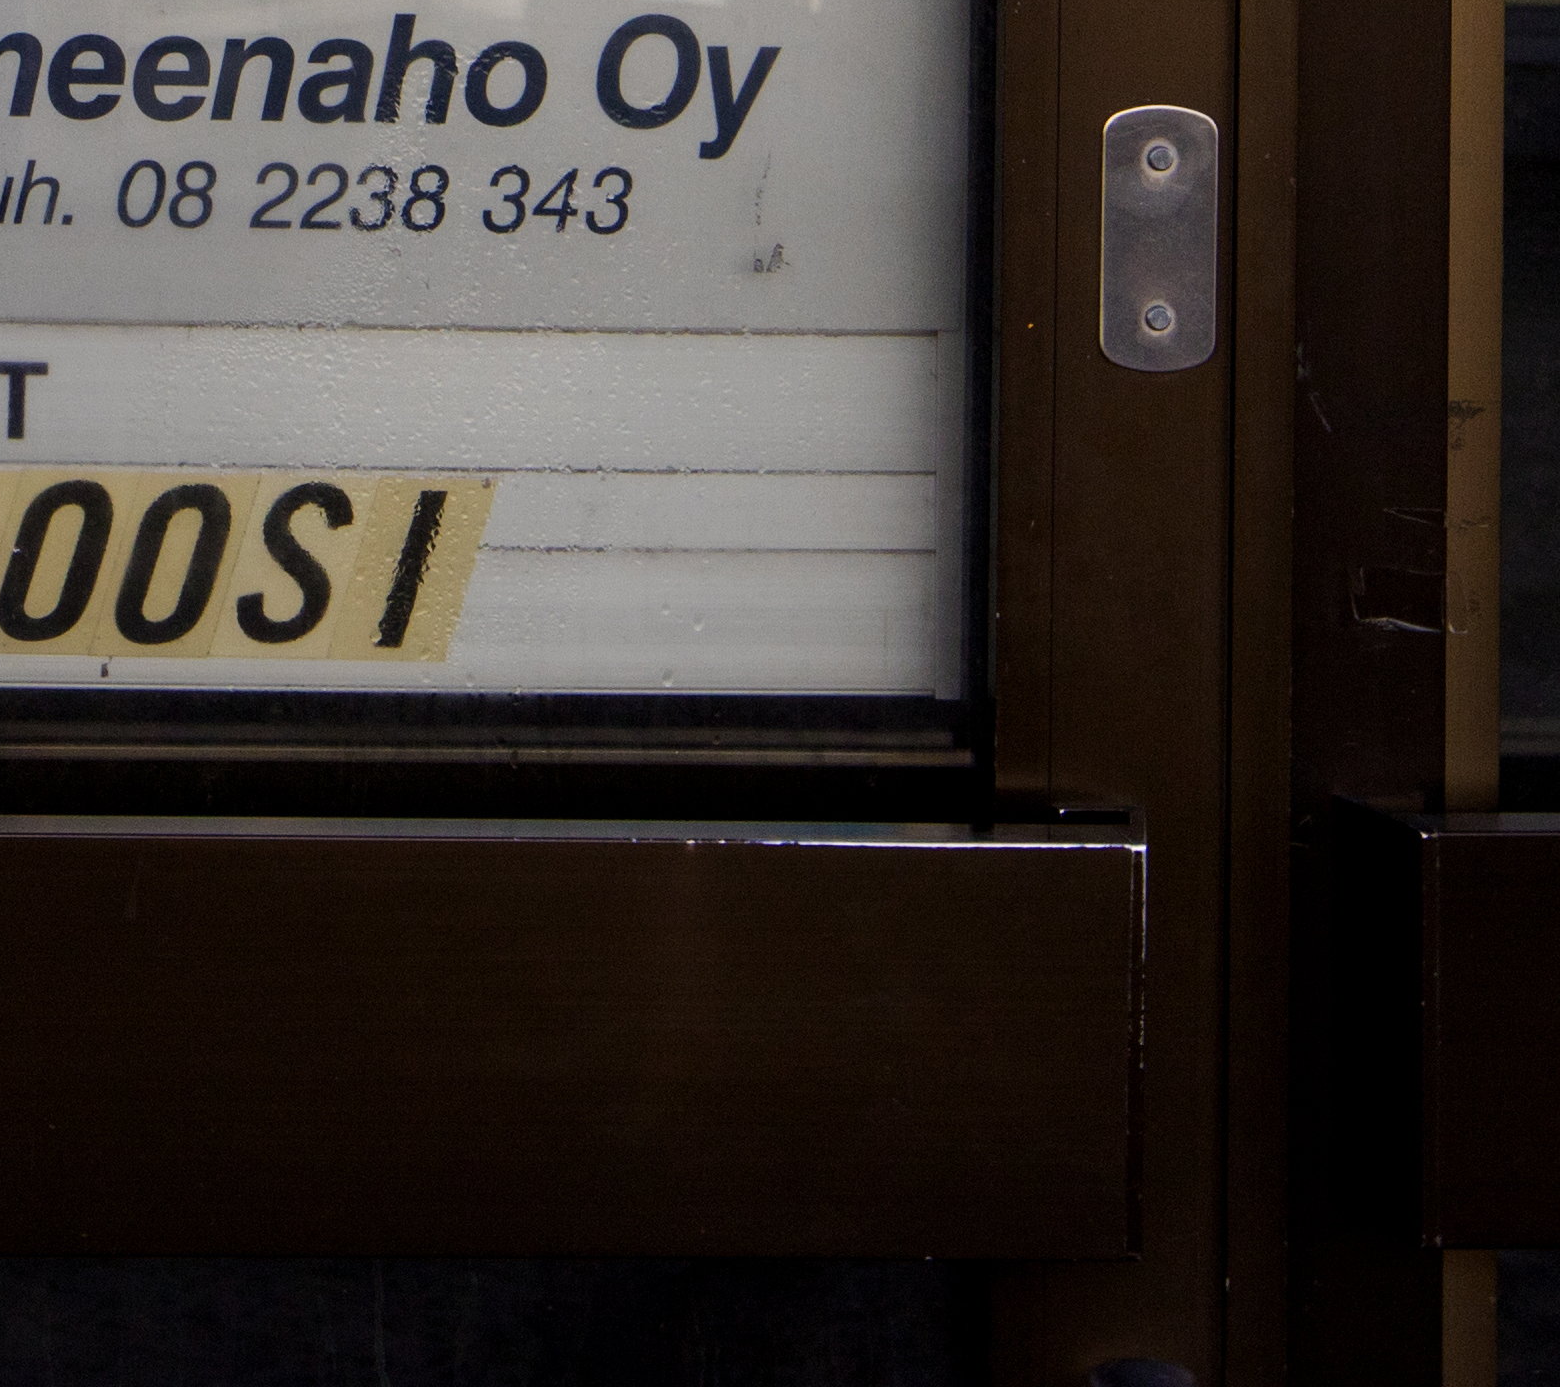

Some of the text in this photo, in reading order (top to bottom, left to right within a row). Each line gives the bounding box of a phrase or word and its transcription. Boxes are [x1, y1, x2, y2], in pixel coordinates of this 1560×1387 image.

[594, 13, 782, 162] Oy
[115, 158, 218, 231] 08
[248, 160, 451, 234] 2238
[480, 163, 634, 237] 343
